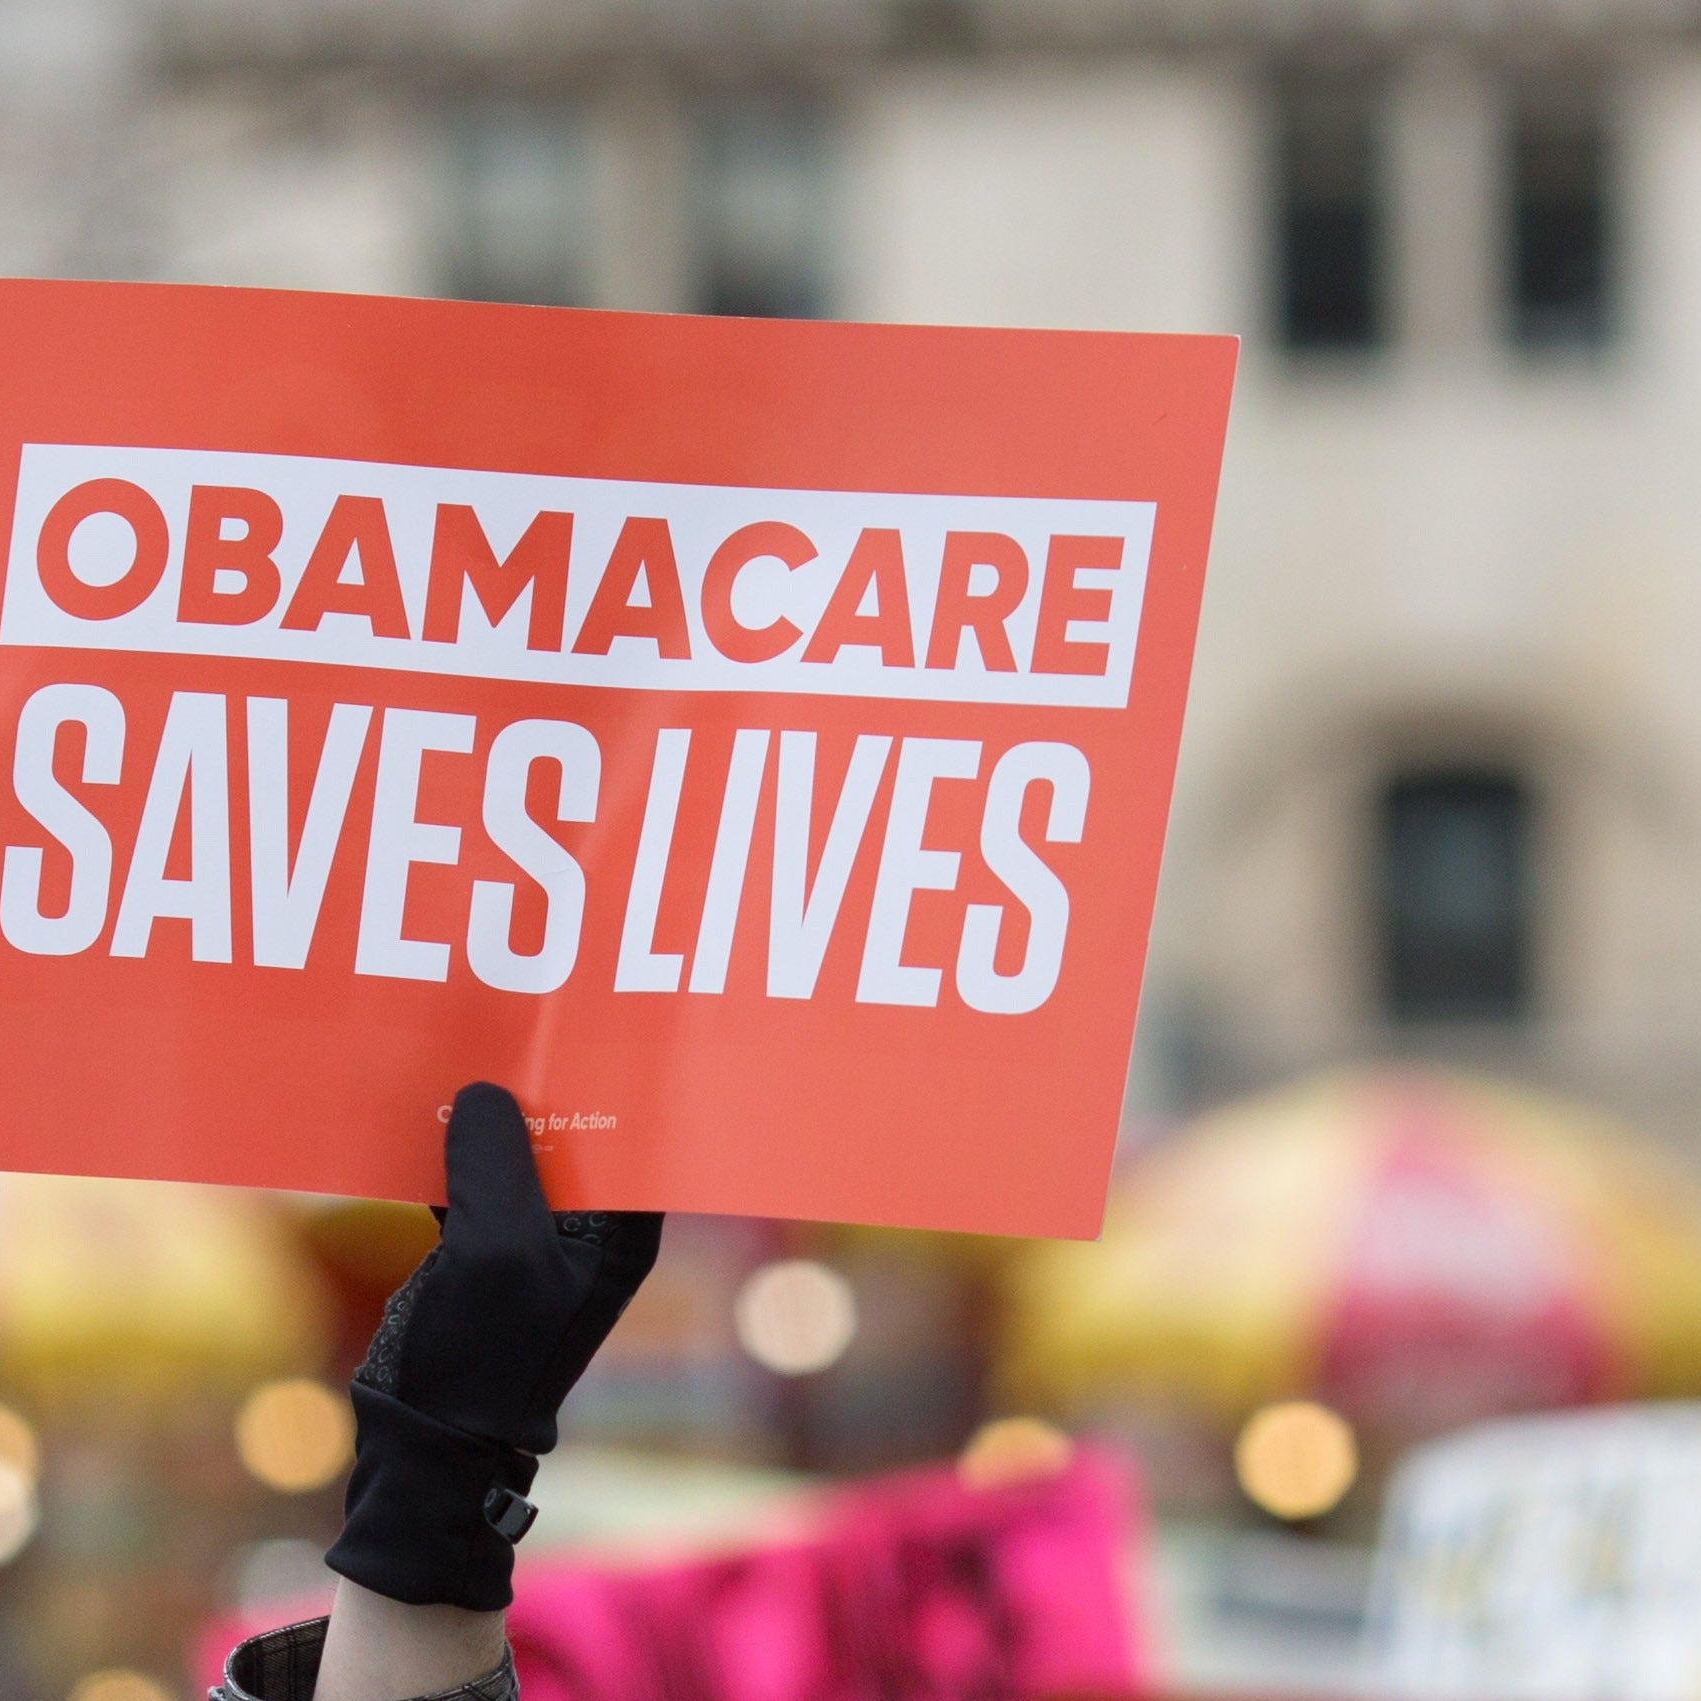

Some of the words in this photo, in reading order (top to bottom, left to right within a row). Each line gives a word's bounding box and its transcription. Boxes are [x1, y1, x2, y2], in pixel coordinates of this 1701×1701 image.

[36, 477, 1125, 677] OBAMACARE
[613, 727, 1091, 1016] LIVES
[549, 1112, 568, 1131] for
[570, 1111, 617, 1131] Action
